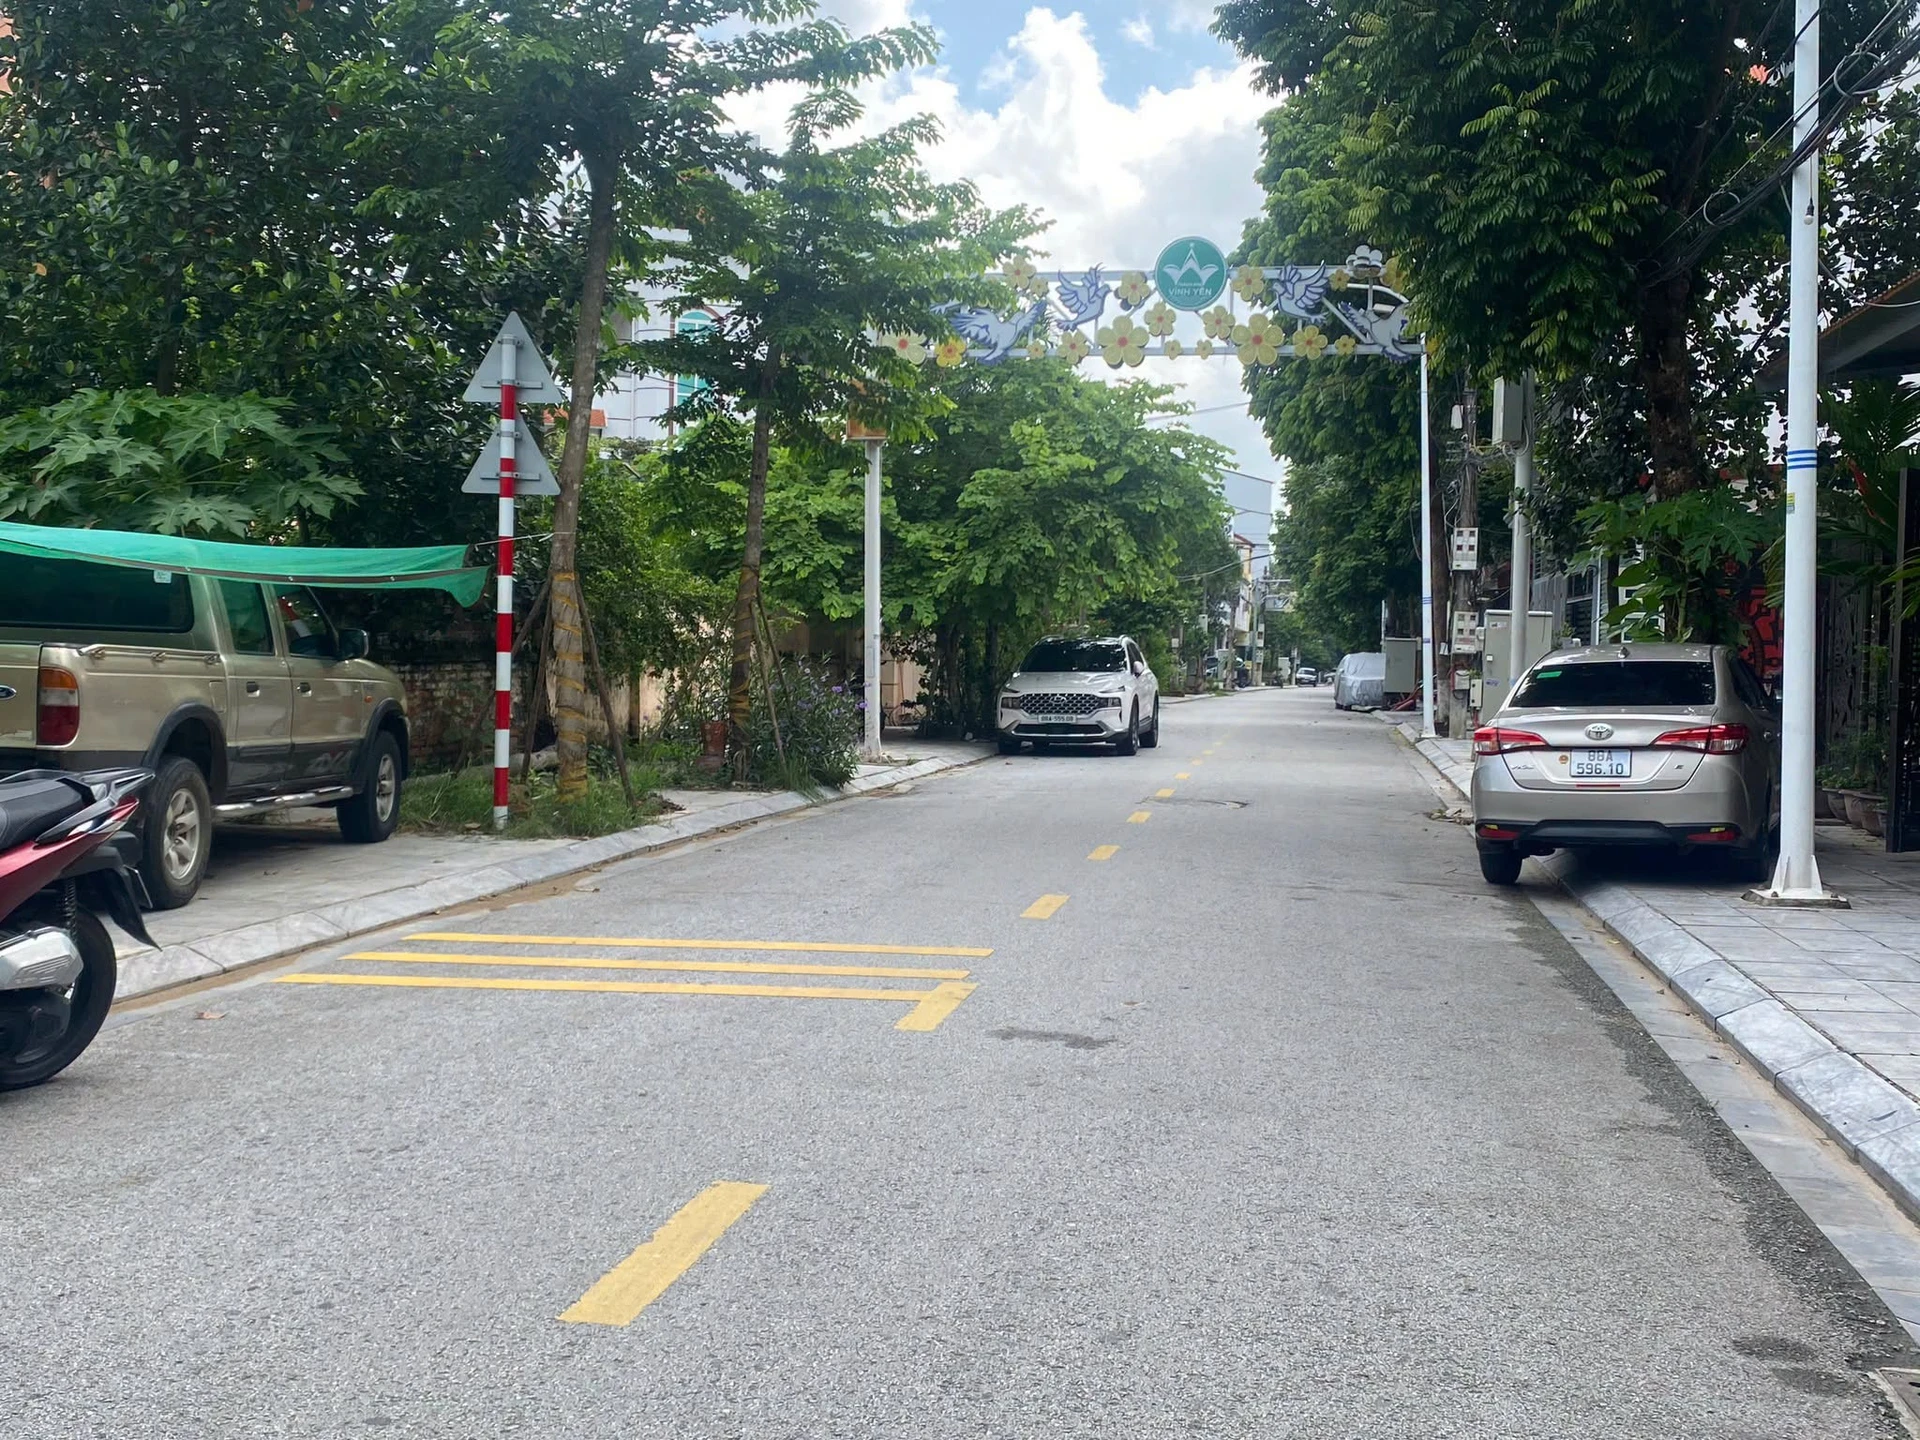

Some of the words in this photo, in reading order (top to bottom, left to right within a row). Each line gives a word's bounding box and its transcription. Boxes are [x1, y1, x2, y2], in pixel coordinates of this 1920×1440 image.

[1192, 286, 1212, 296] YÊN
[1587, 750, 1613, 761] 88A
[1576, 763, 1624, 775] 596.10
